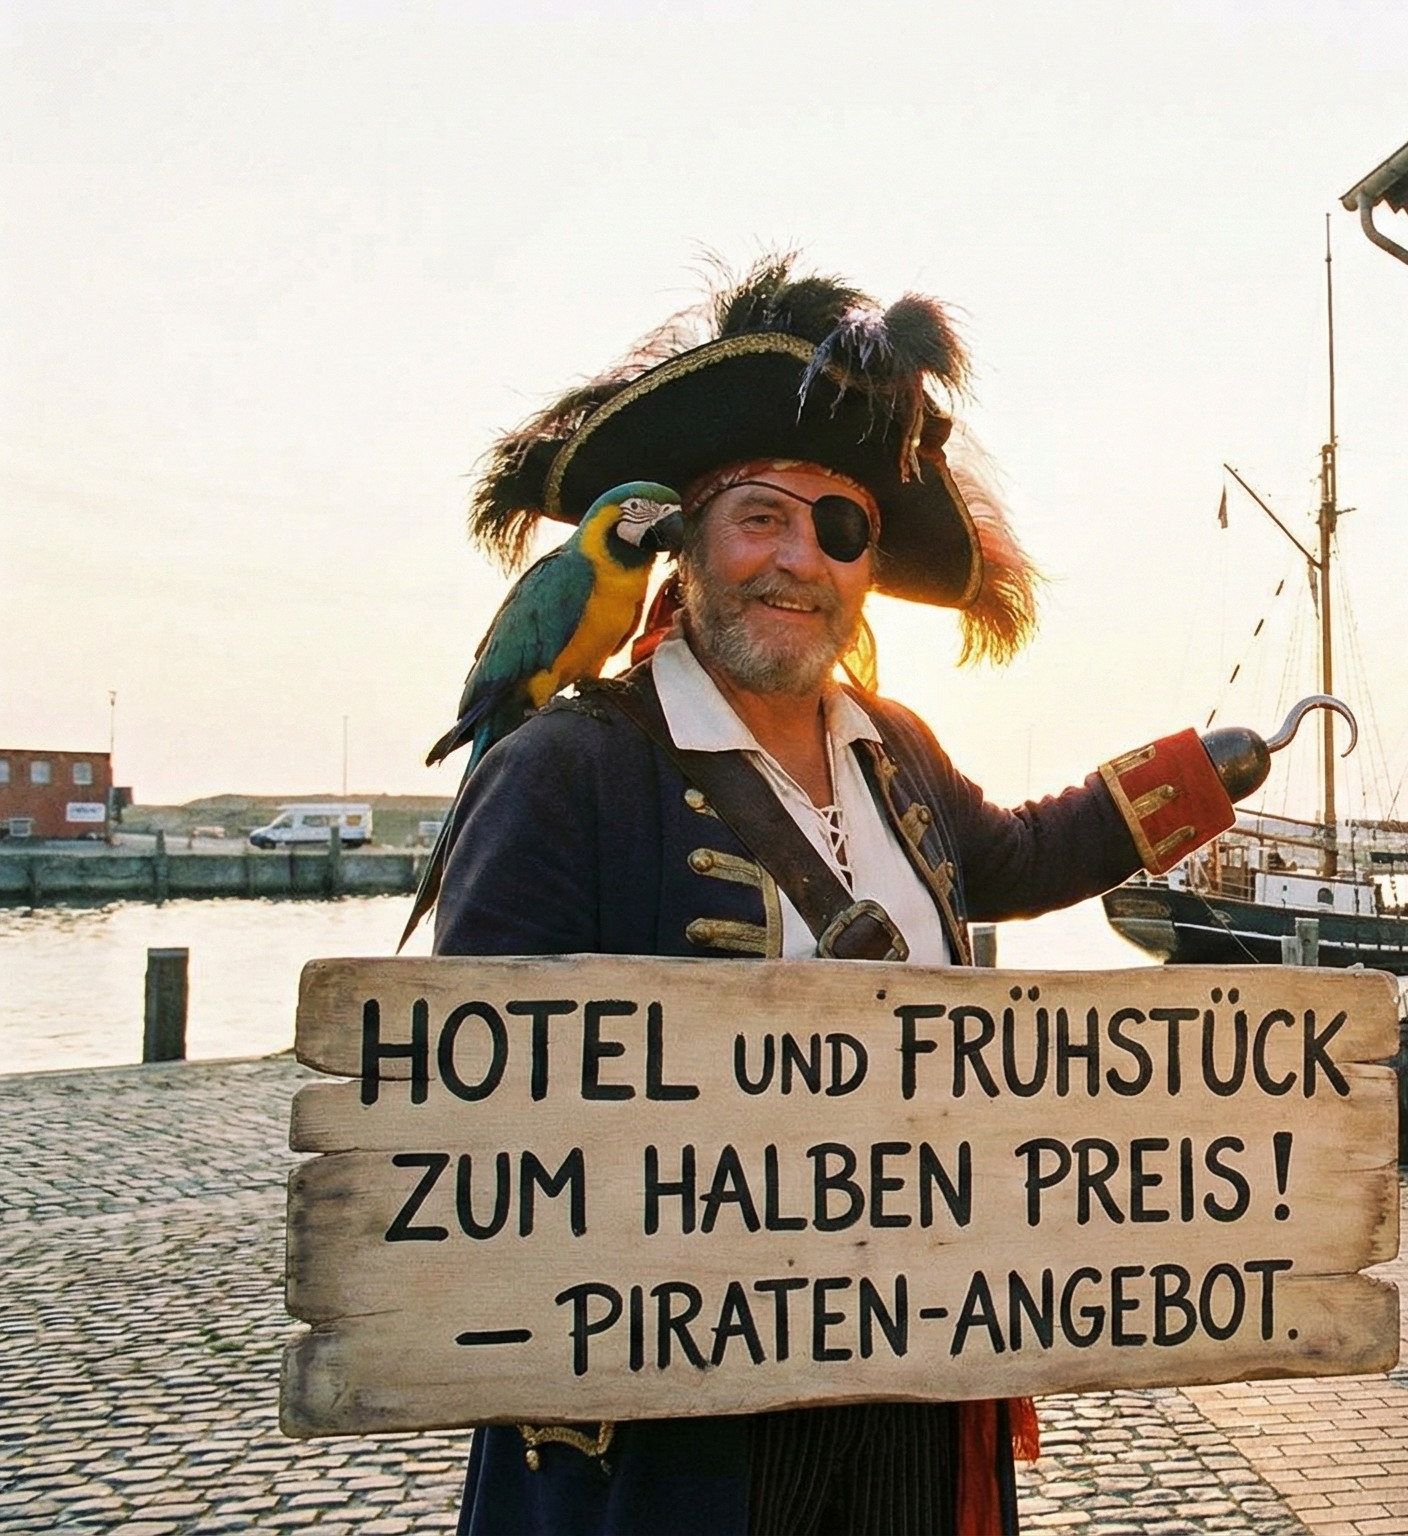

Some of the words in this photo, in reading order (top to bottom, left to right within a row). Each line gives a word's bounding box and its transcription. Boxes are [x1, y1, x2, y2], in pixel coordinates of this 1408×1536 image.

[362, 999, 699, 1107] HOTEL
[733, 1032, 869, 1098] UND
[897, 985, 1353, 1103] FRÜHSTÜCK
[385, 1146, 587, 1244] ZUM
[643, 1140, 973, 1237] HALBEN
[1016, 1130, 1296, 1229] PREIS!
[554, 1258, 1300, 1379] PIRATEN-ANGEBOT.
